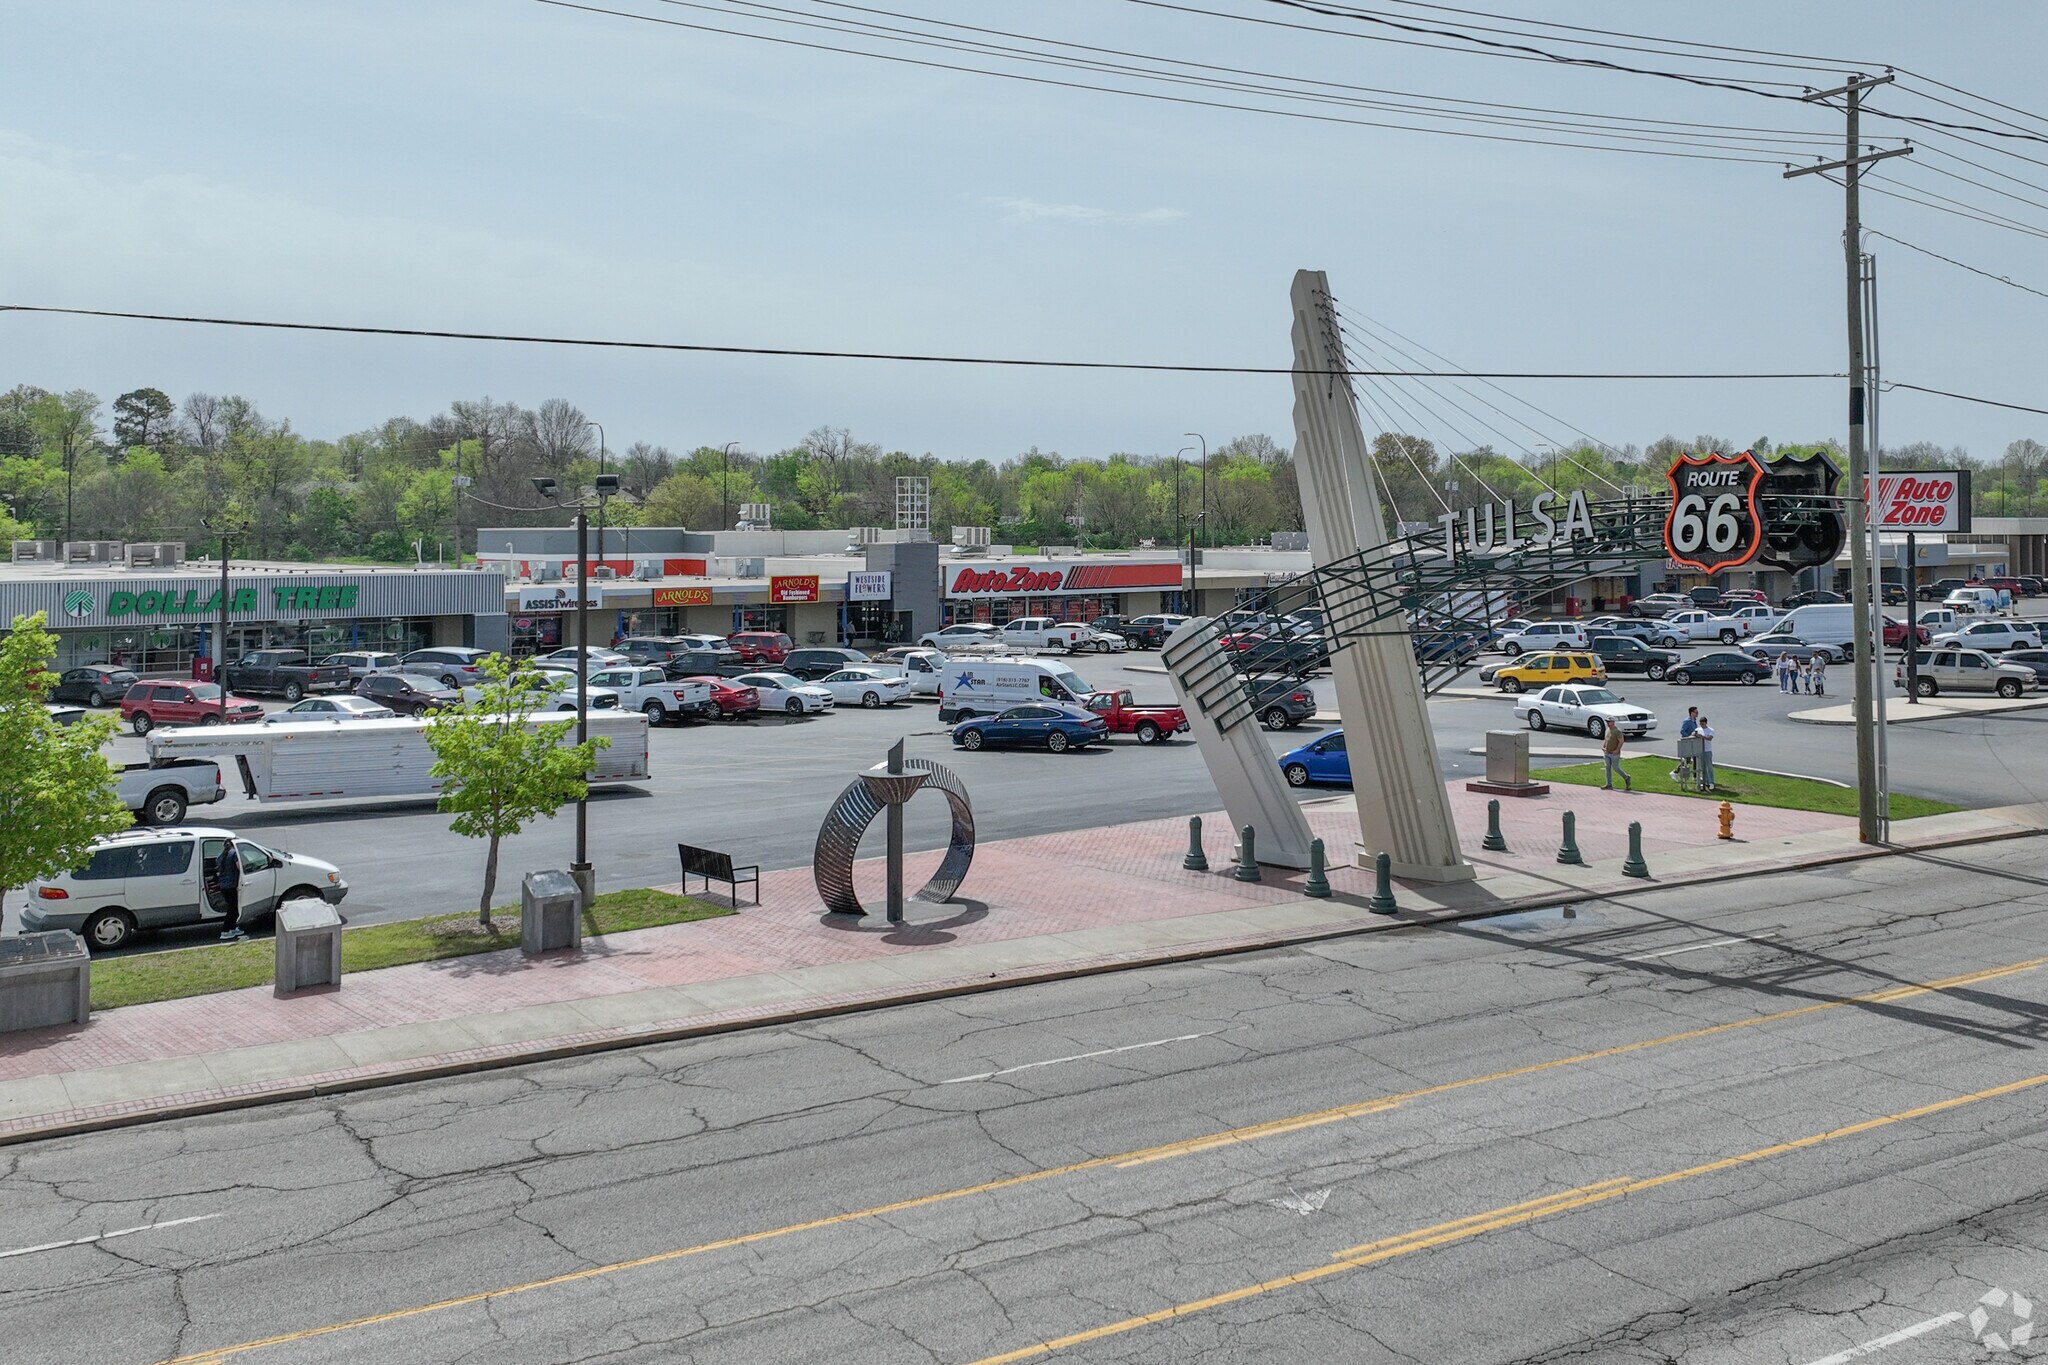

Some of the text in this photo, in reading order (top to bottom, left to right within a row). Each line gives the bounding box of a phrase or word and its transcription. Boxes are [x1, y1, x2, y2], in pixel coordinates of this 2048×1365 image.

[1687, 470, 1739, 487] ROUTE
[1894, 477, 1953, 501] Auto
[1672, 493, 1741, 553] 66
[1883, 501, 1945, 524] Zone
[1438, 490, 1595, 563] TULSA
[774, 578, 816, 590] ARNOLD'S
[855, 575, 885, 583] WESTSIDE
[855, 583, 886, 593] FLOWERS
[952, 566, 1063, 593] AutoZone
[108, 585, 359, 616] DOLLAR TREE
[657, 589, 709, 604] ARNOLD'S
